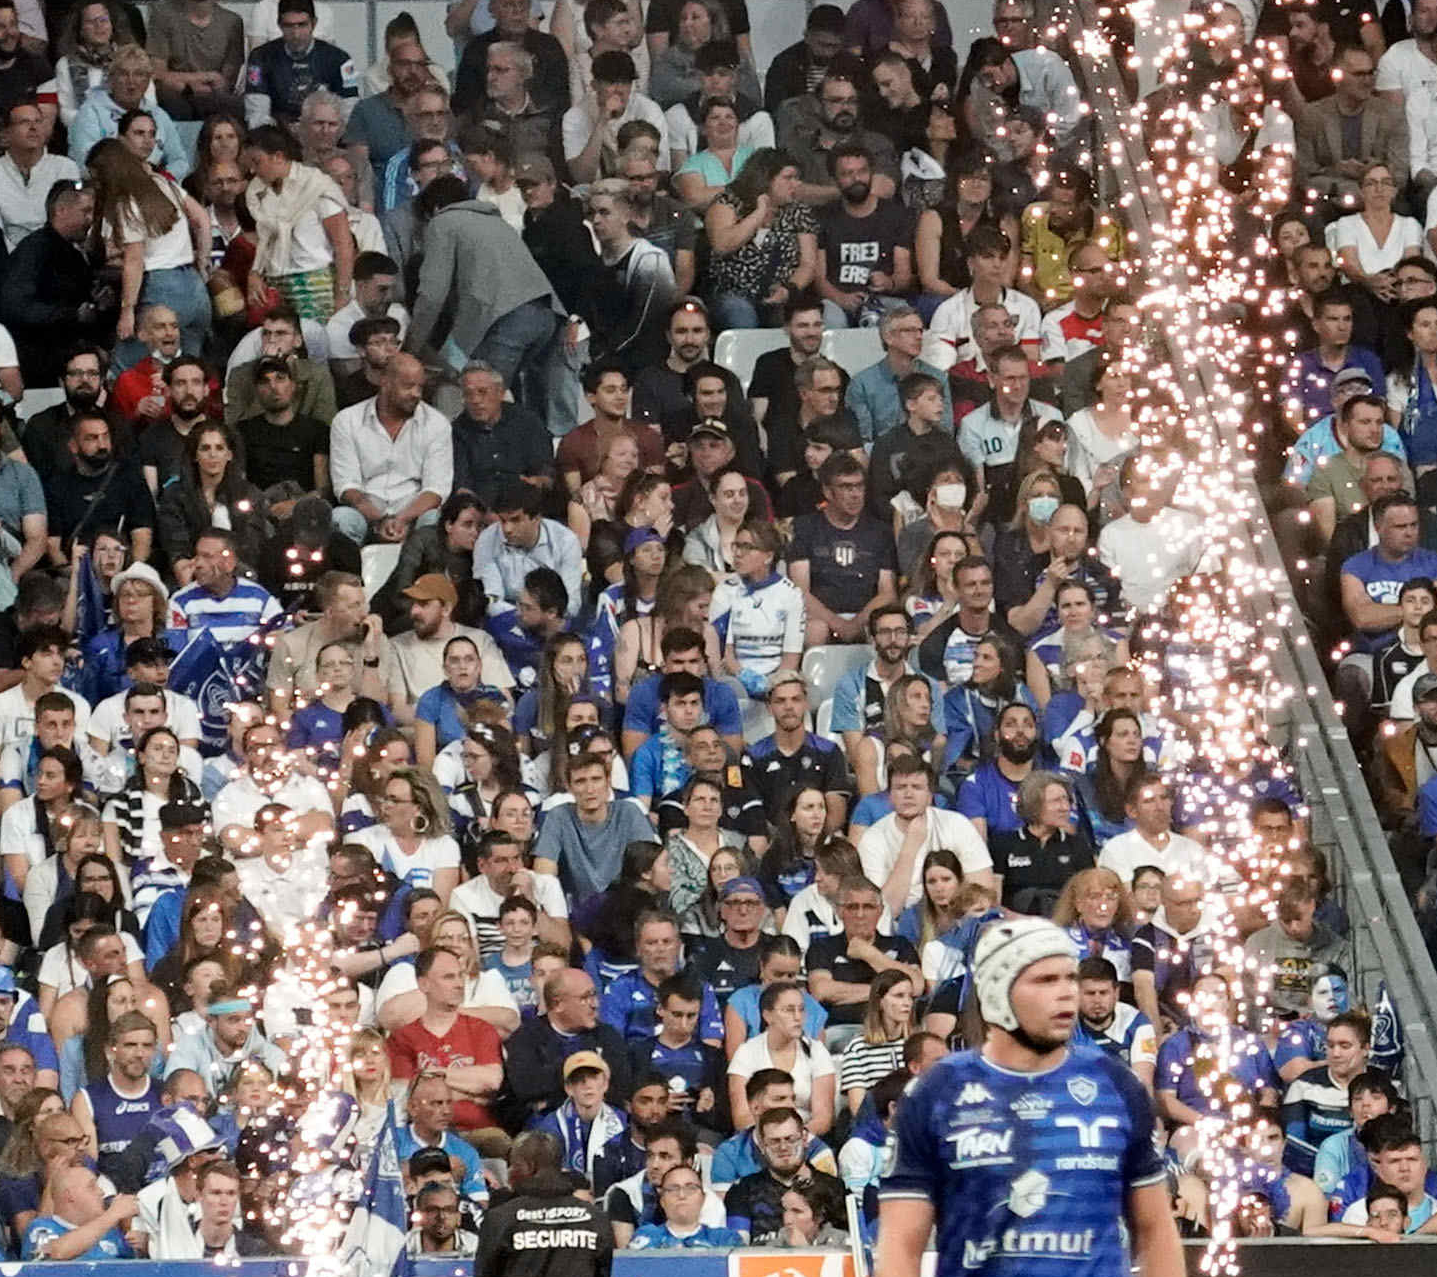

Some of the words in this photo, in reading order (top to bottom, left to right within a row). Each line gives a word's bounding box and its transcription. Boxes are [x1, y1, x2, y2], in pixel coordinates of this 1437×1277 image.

[983, 437, 1002, 455] 10
[946, 1127, 1013, 1161] TARN
[1055, 1153, 1118, 1170] randstad
[513, 1229, 598, 1251] SECURITE
